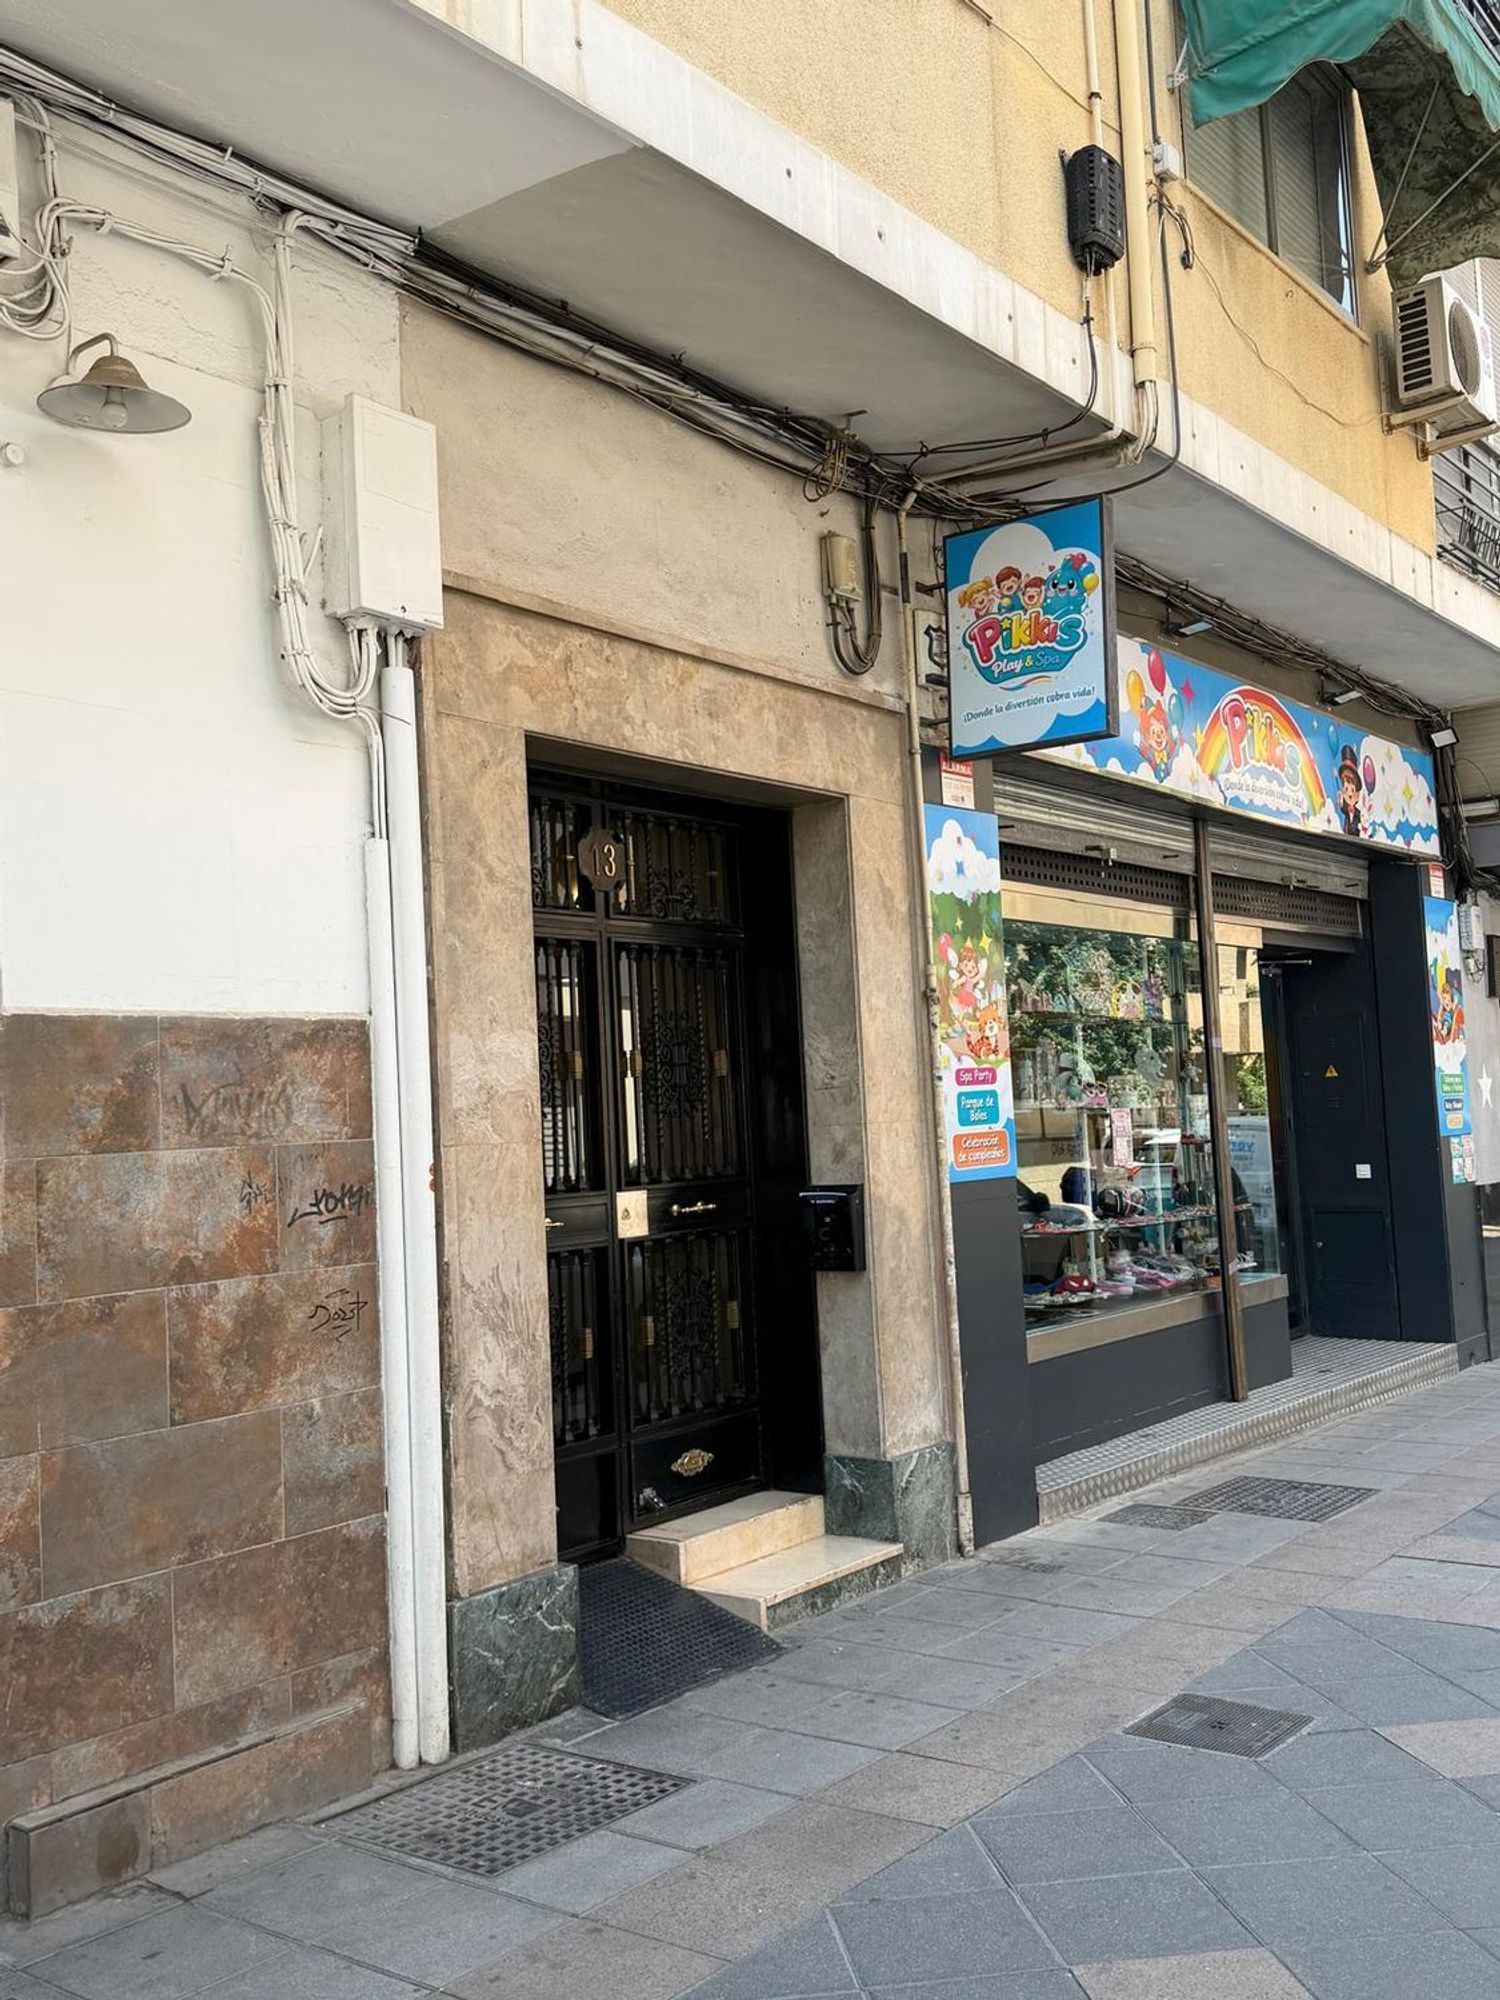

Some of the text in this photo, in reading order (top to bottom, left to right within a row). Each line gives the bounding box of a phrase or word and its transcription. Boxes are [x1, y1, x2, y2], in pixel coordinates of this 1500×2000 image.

[992, 651, 1060, 677] Play & Spa
[963, 685, 1095, 723] ¡Donde la diversión cobra vida!
[592, 843, 615, 876] 13
[974, 1069, 993, 1083] Party
